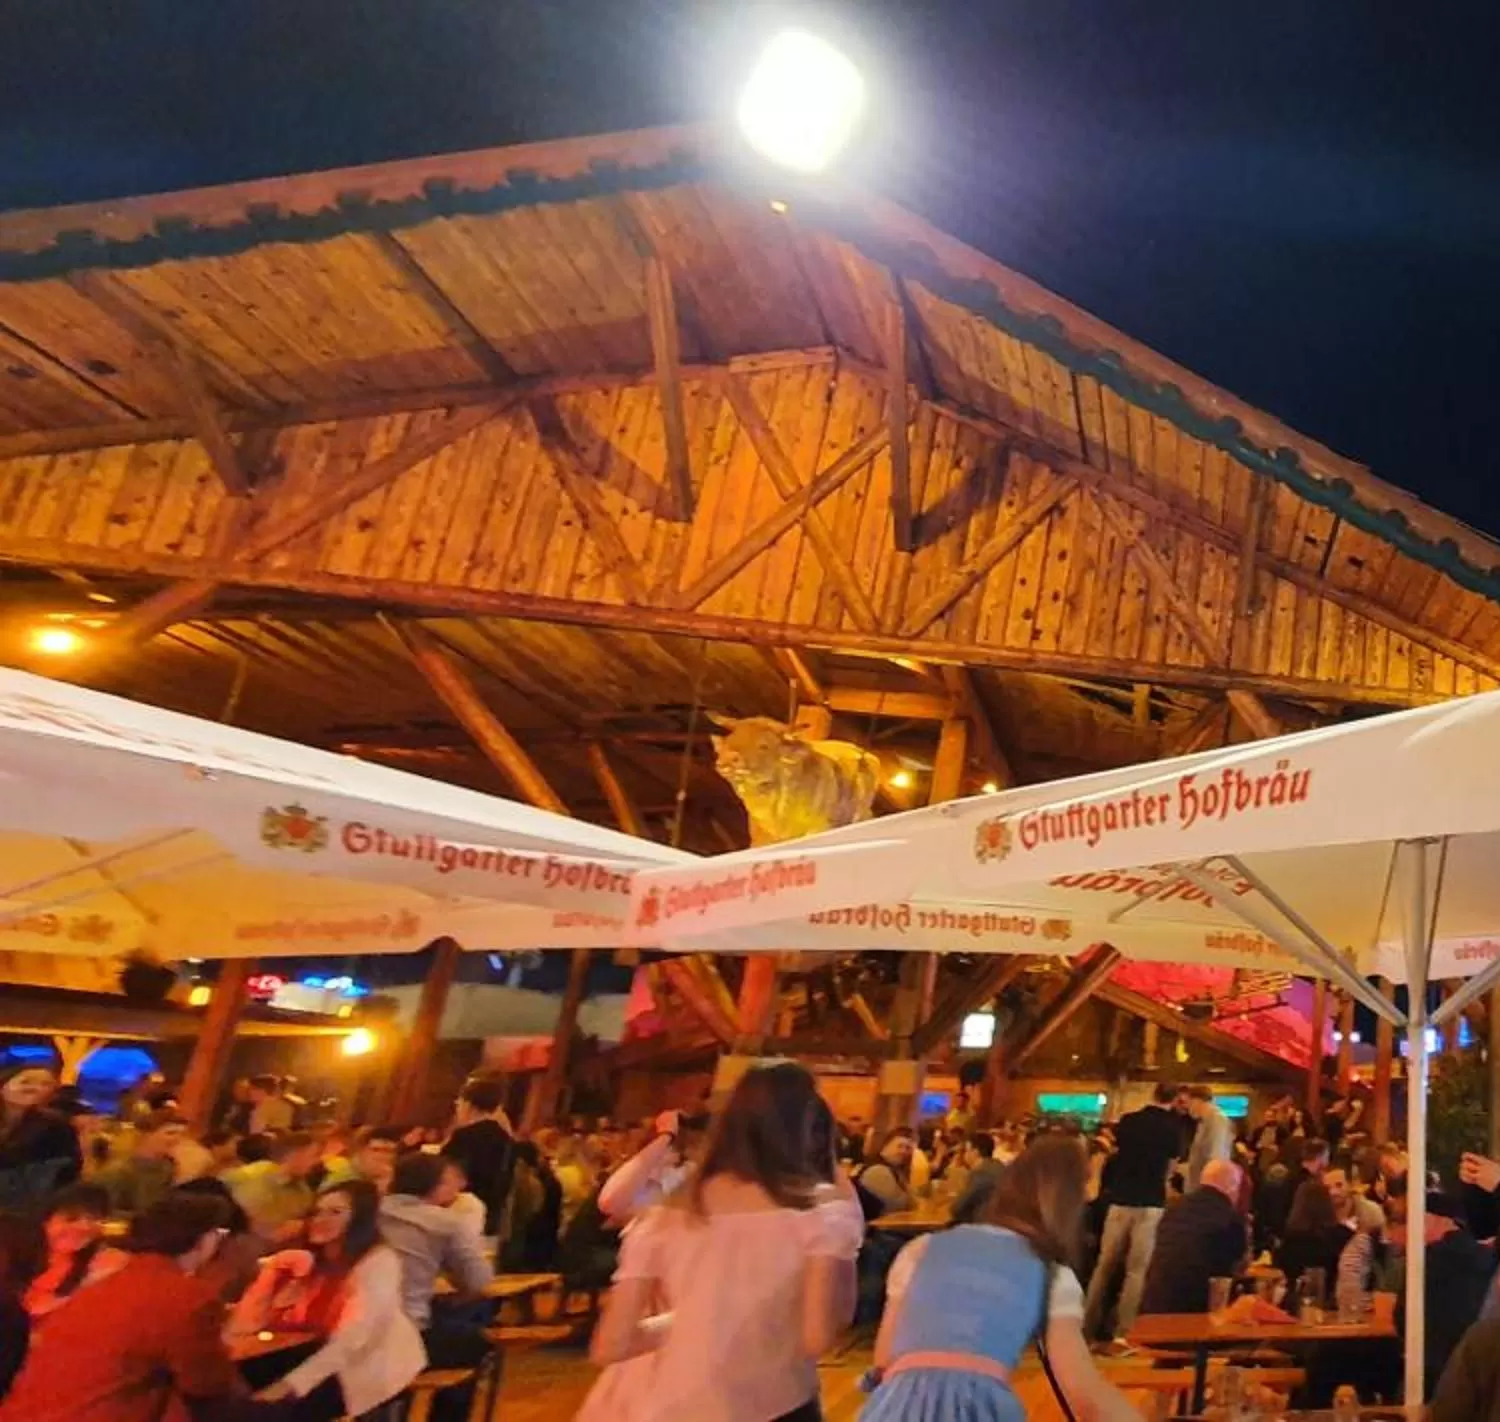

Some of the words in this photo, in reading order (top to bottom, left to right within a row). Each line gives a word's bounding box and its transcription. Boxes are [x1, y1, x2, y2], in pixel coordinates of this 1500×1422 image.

[1018, 788, 1171, 850] Stuttgarter
[1177, 760, 1312, 830] Hofbräu
[340, 821, 539, 878] Stuttgarter
